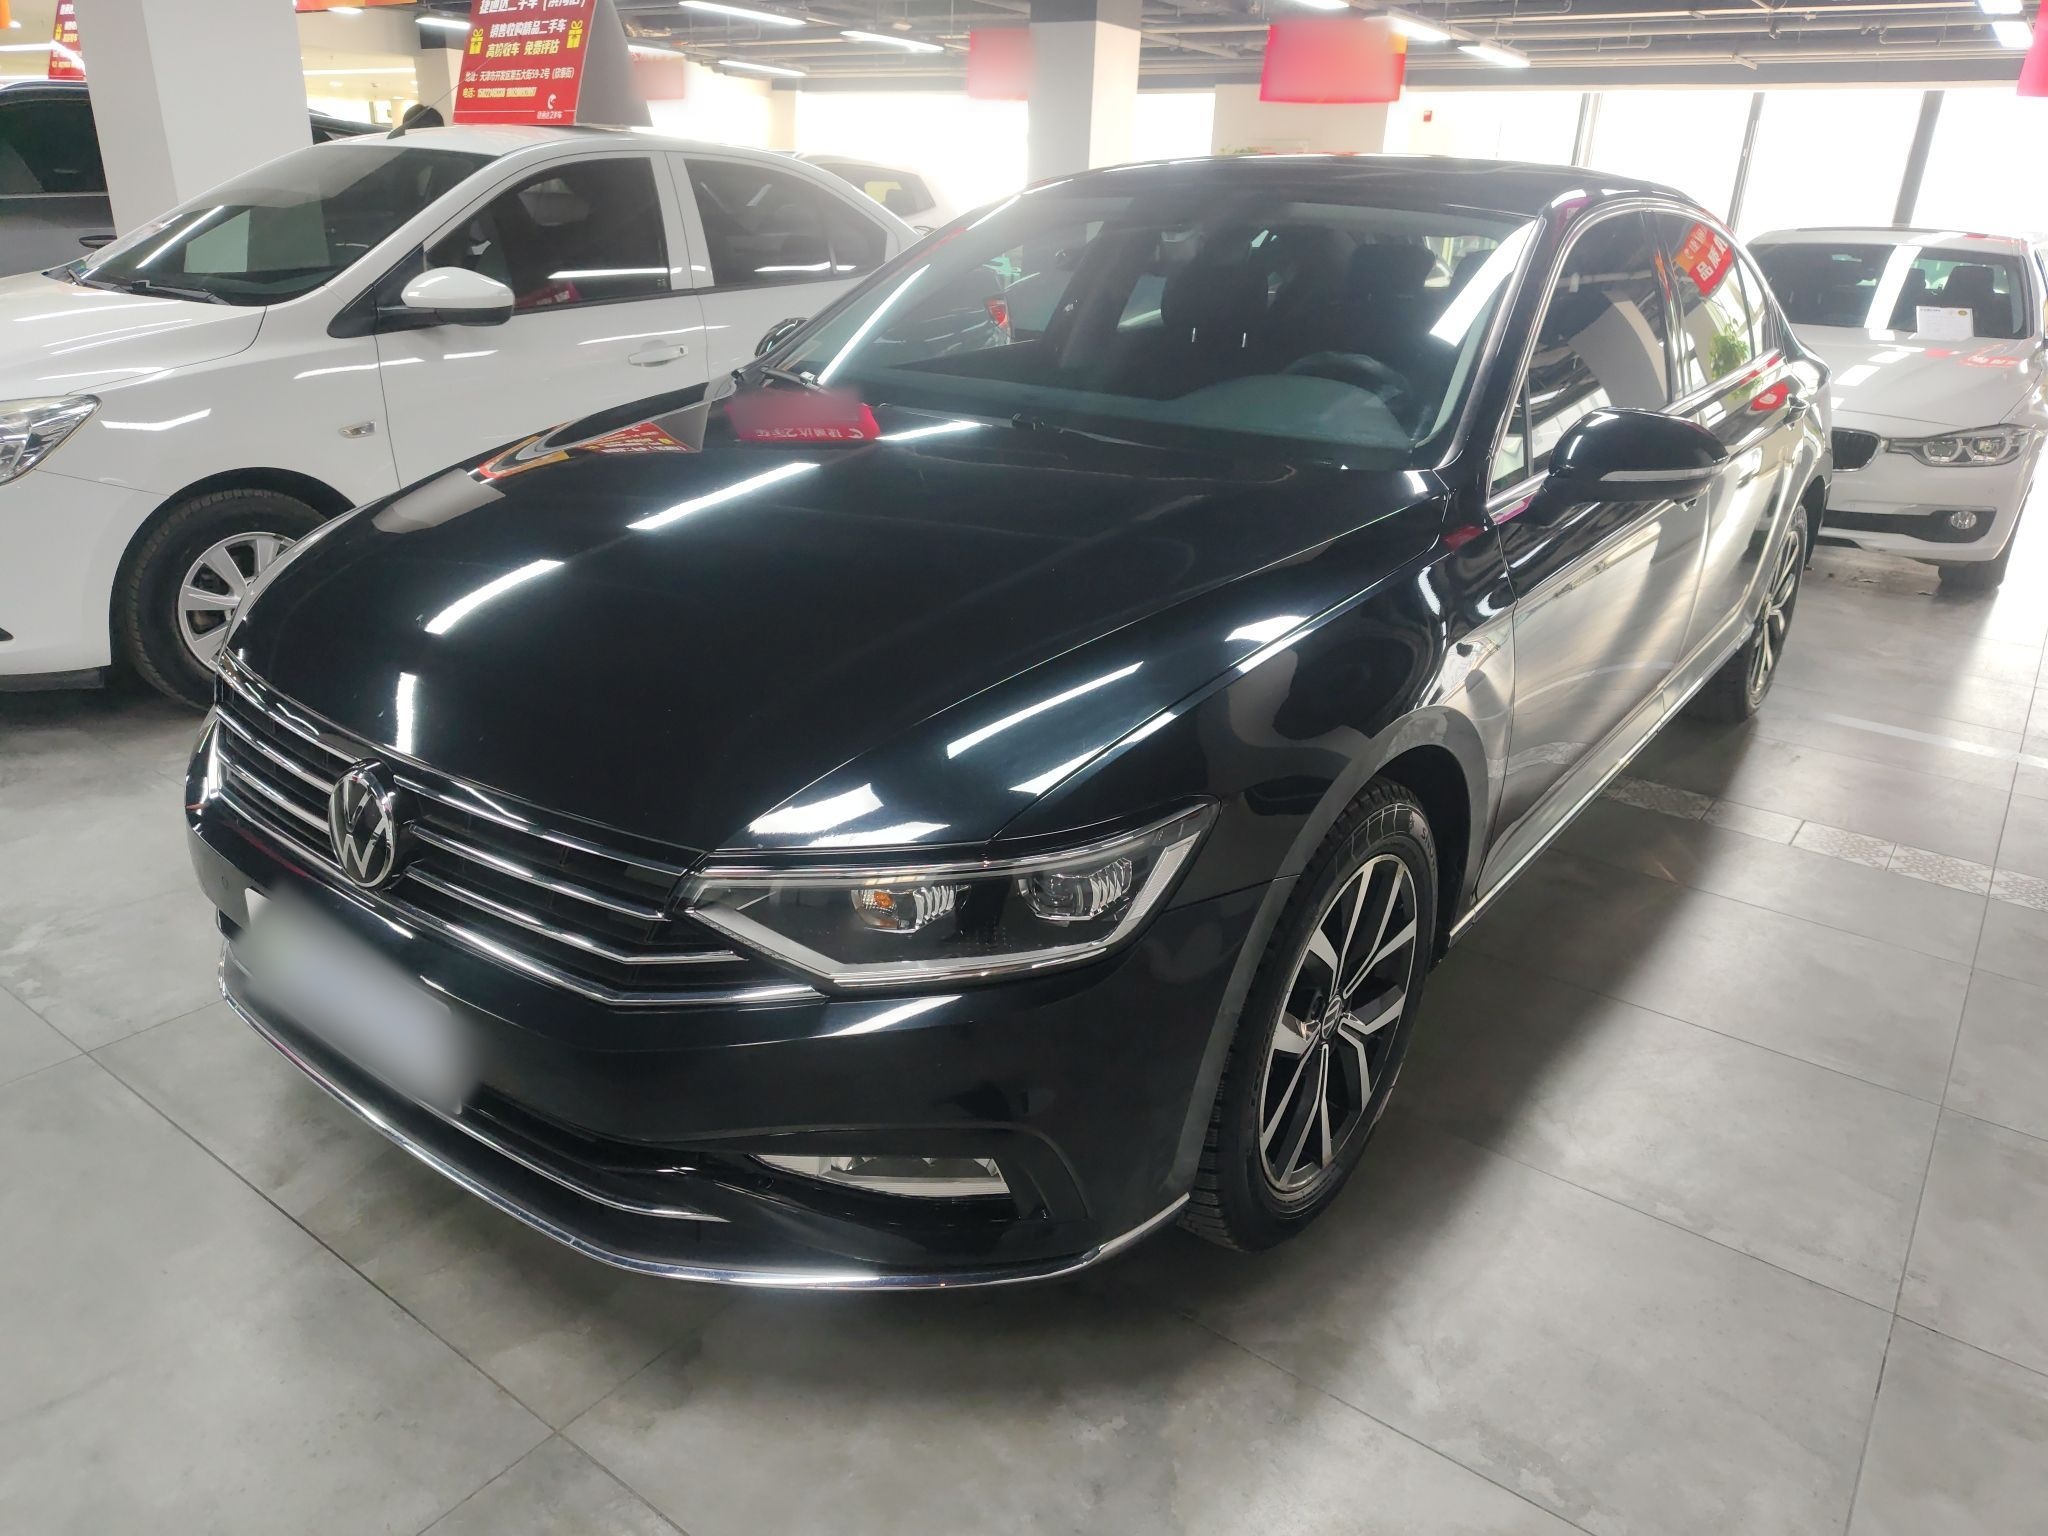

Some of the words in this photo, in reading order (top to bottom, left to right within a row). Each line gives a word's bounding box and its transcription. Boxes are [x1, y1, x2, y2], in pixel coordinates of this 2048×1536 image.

[490, 19, 567, 38] 销售收购精品二手车
